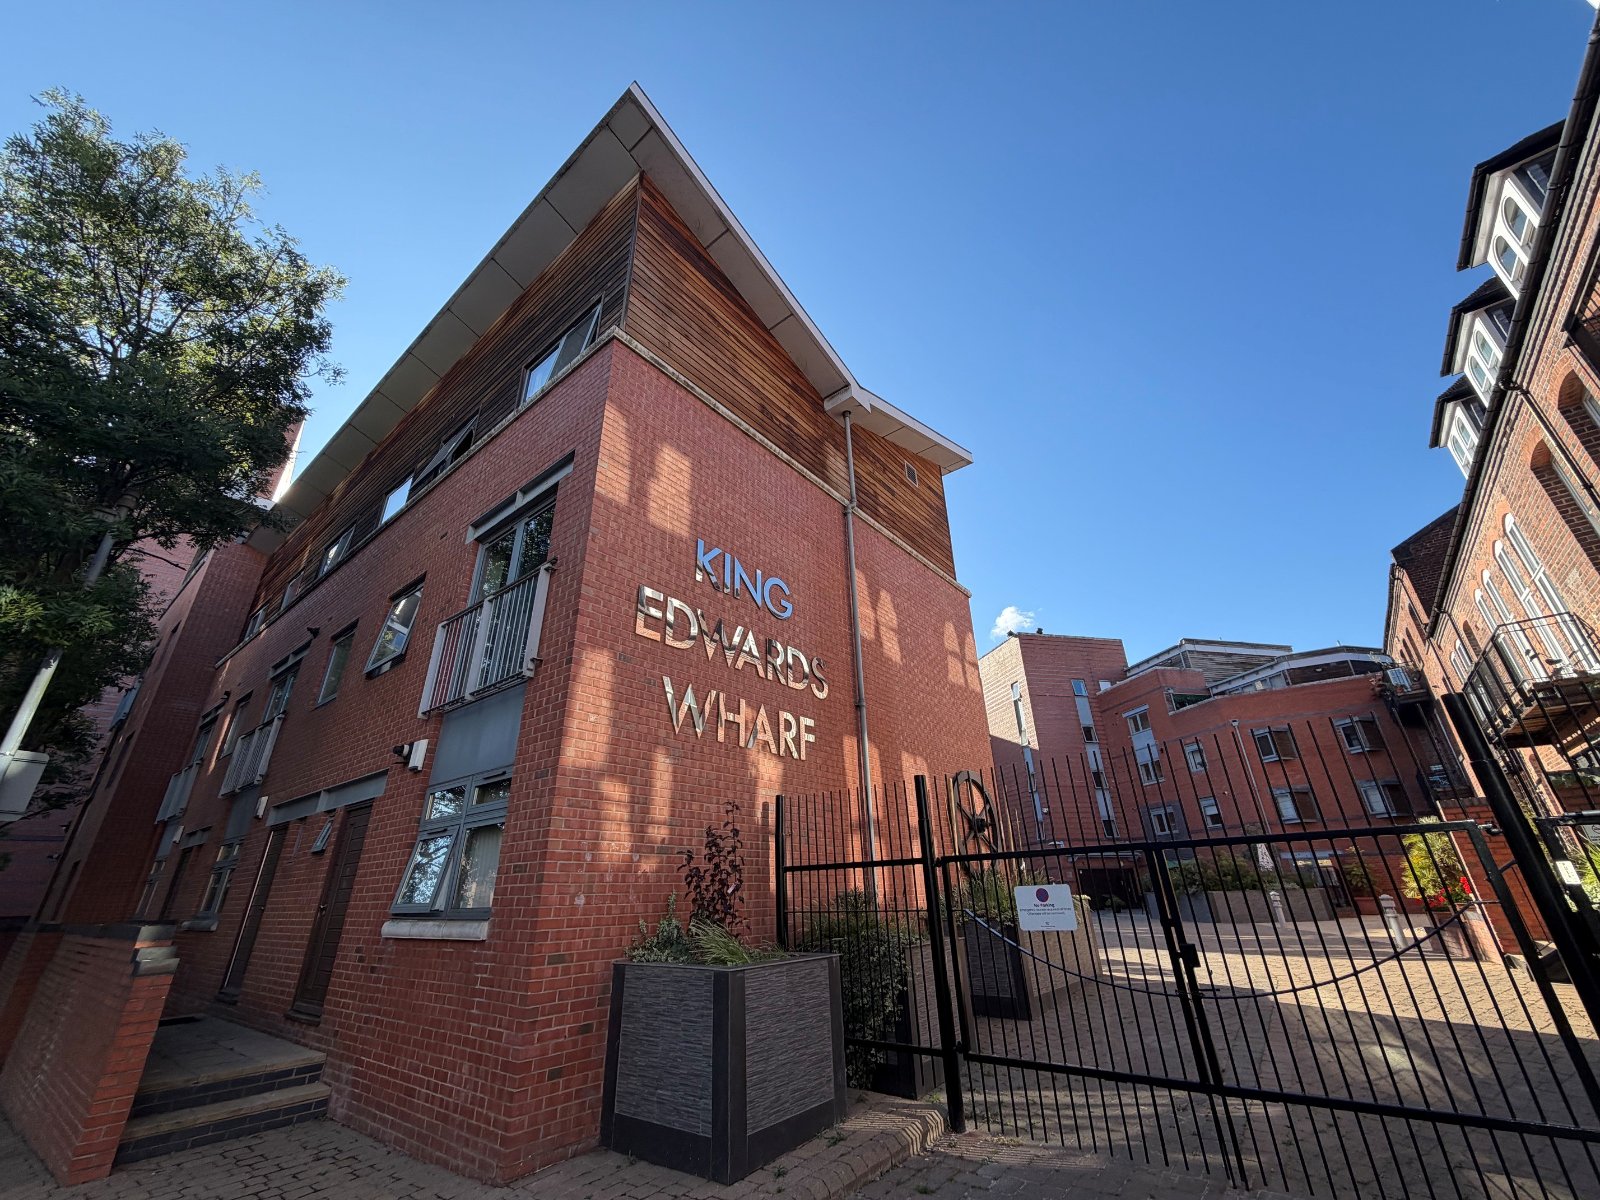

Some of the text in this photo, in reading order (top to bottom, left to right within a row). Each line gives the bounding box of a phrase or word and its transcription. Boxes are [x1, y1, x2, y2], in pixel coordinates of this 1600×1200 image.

[695, 538, 794, 620] KING
[635, 584, 829, 700] EDWARDS
[662, 675, 816, 761] WHARF
